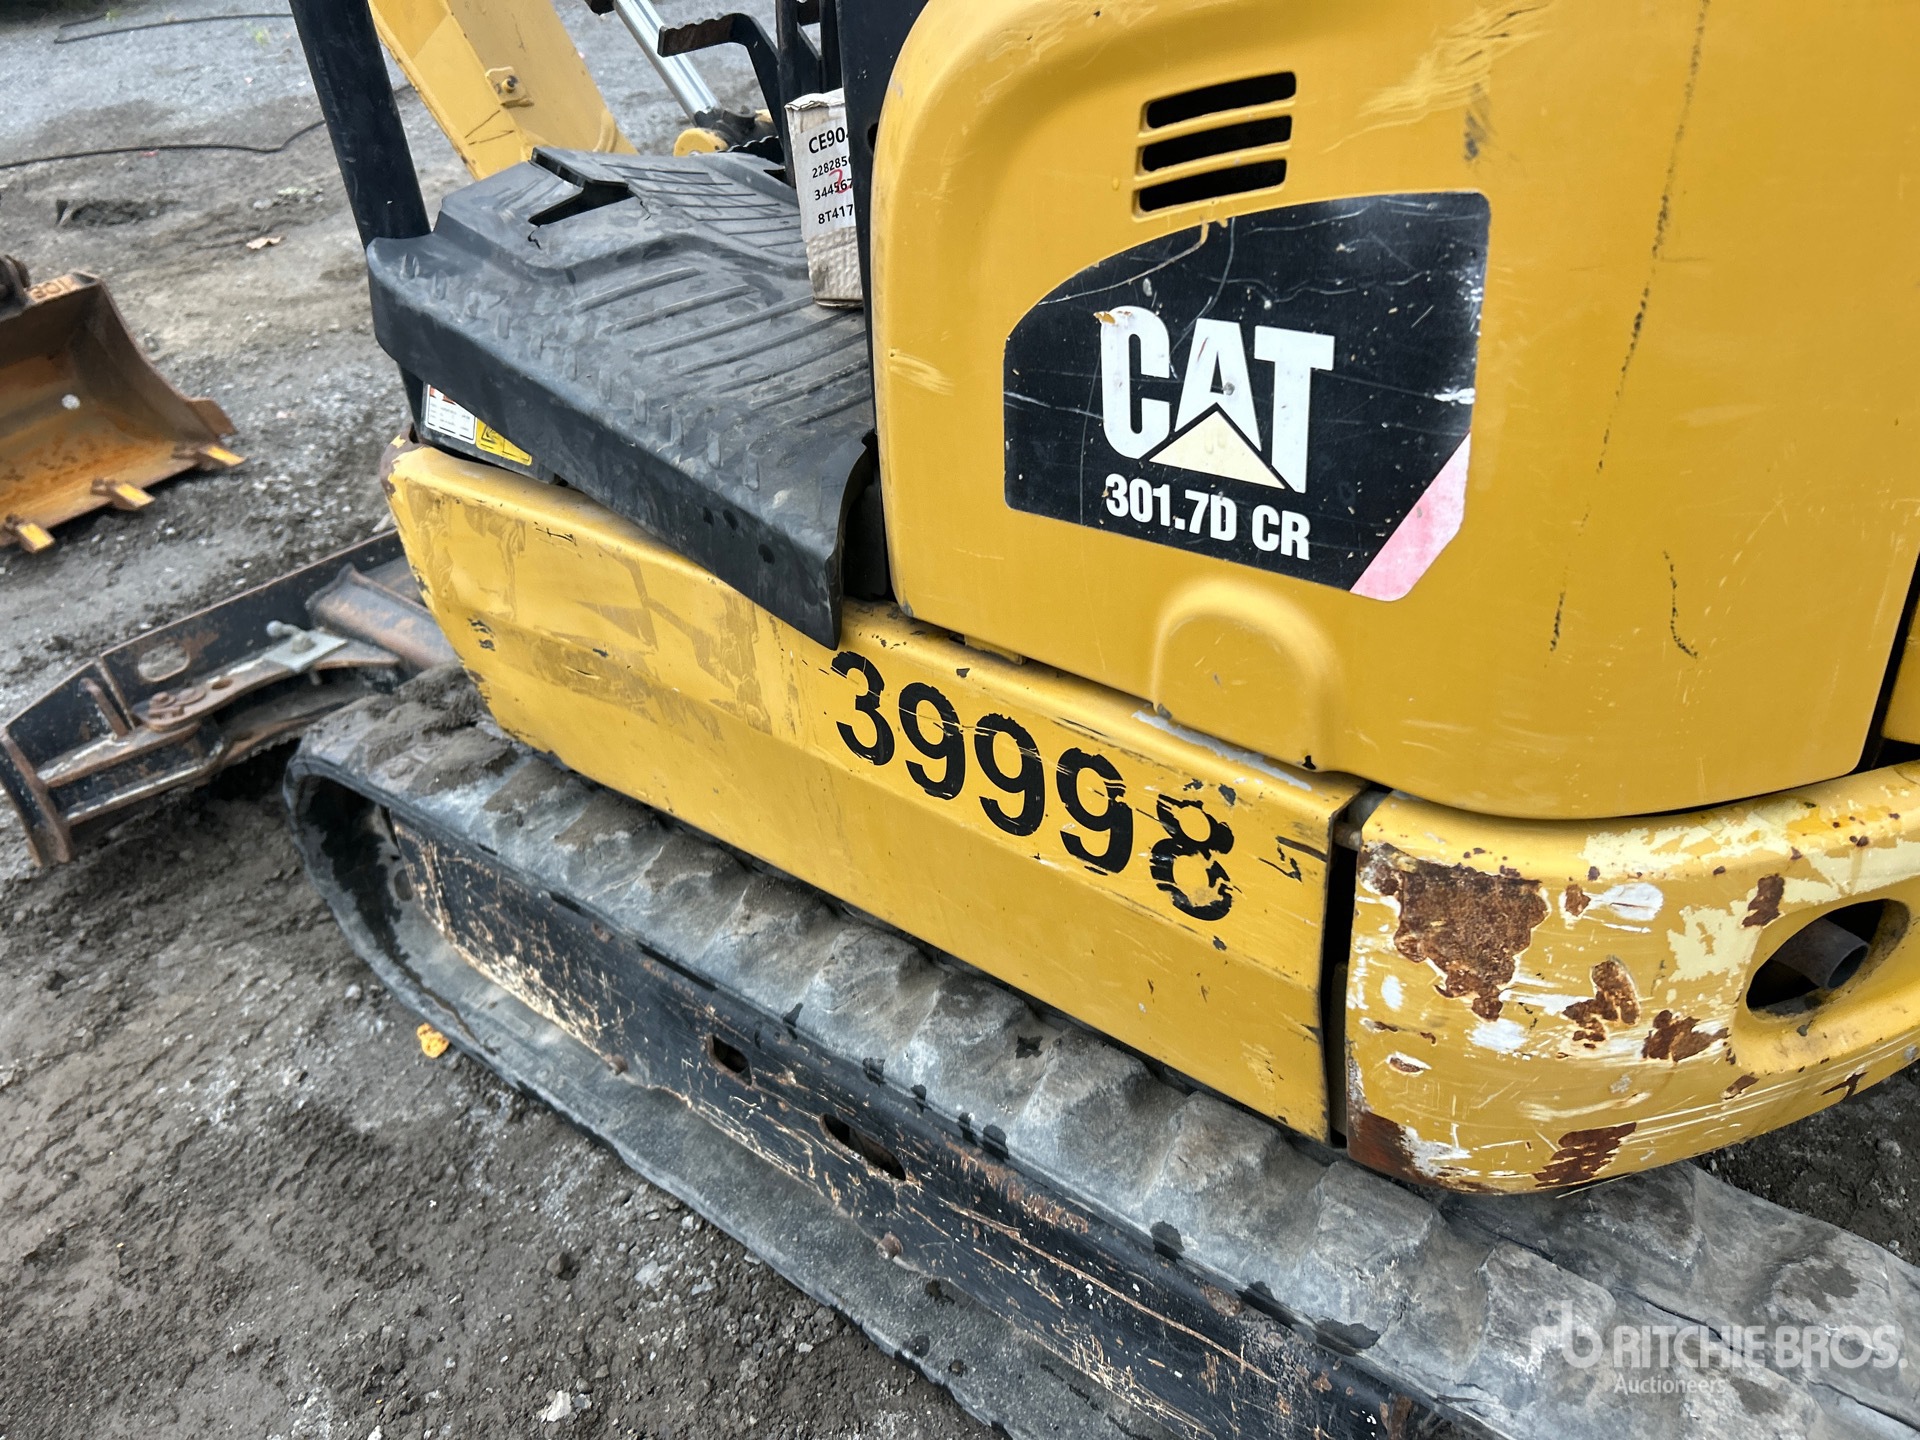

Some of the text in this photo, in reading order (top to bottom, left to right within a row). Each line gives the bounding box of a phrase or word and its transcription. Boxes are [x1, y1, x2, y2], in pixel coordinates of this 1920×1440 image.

[808, 126, 849, 154] CE90
[812, 155, 851, 178] 228285
[818, 204, 854, 225] 8T417
[1098, 305, 1335, 493] CAT
[1105, 473, 1310, 560] 301.7D CR
[831, 651, 1236, 921] 39998
